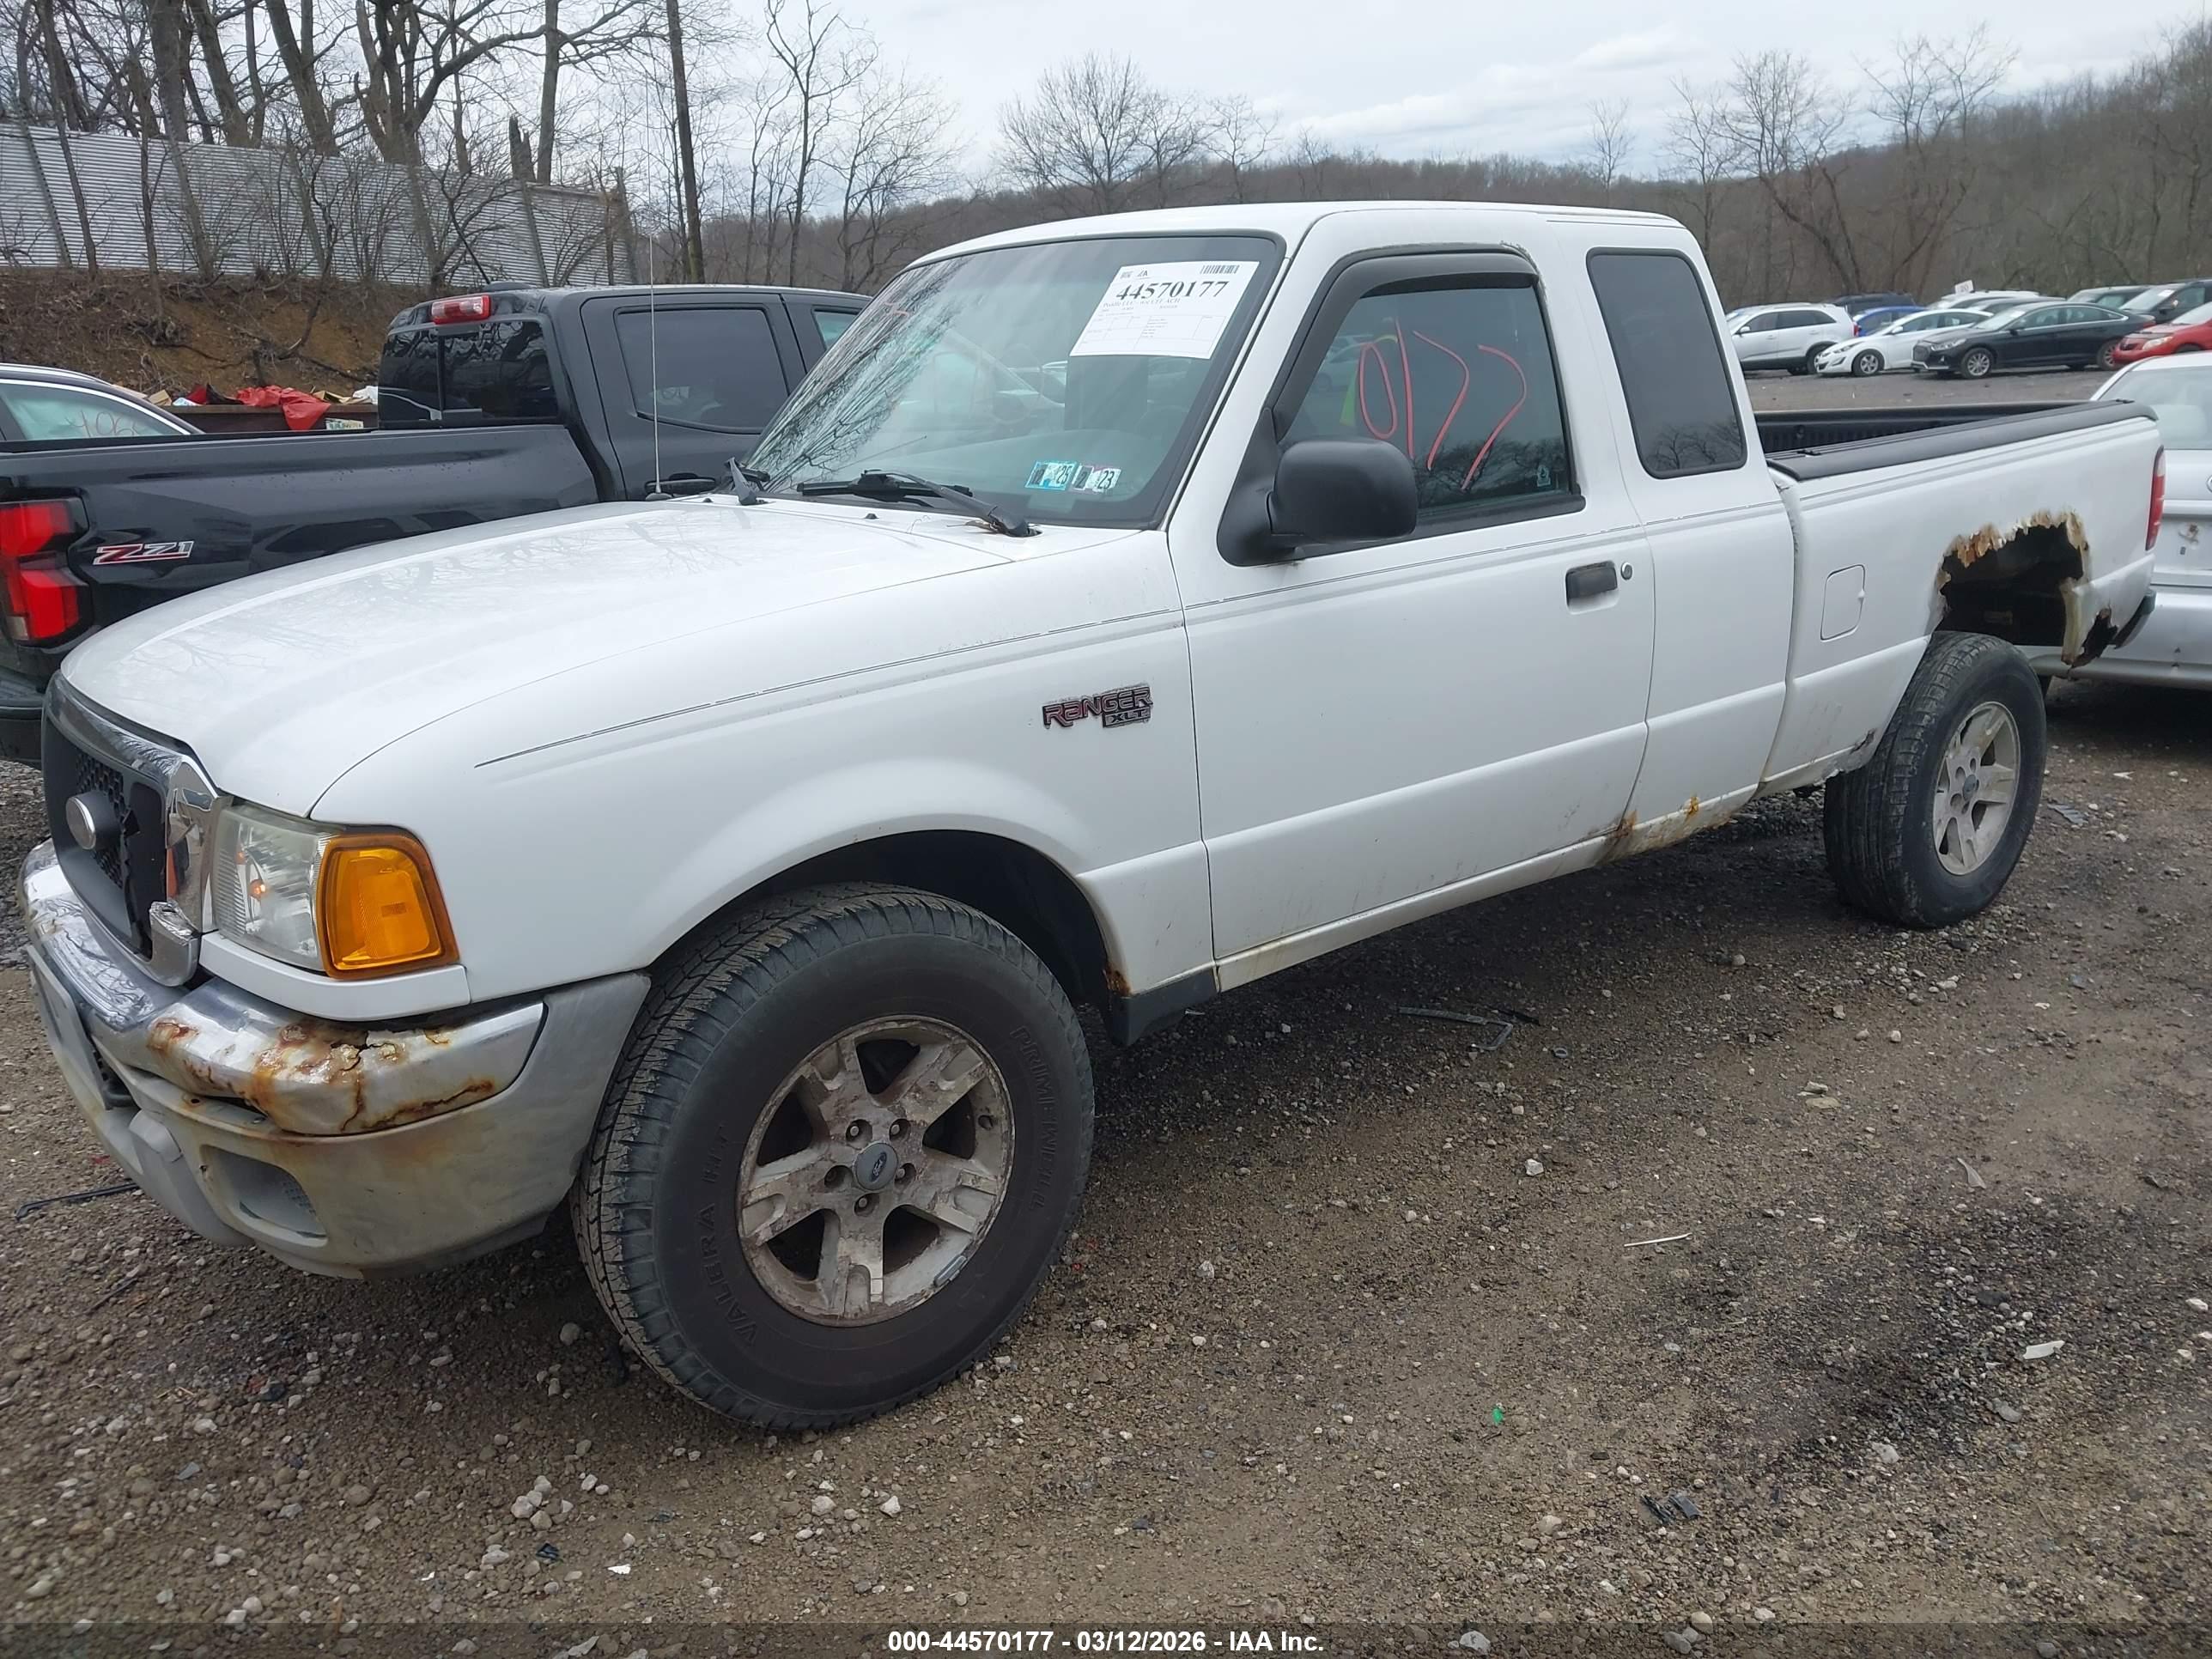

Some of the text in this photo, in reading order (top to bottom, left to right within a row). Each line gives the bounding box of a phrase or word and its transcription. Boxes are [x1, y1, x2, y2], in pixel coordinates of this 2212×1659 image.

[1115, 280, 1230, 301] 44570177
[93, 540, 194, 565] Z71
[1042, 685, 1154, 727] RANGER
[1107, 707, 1151, 726] XLT
[693, 1202, 757, 1346] VALERA
